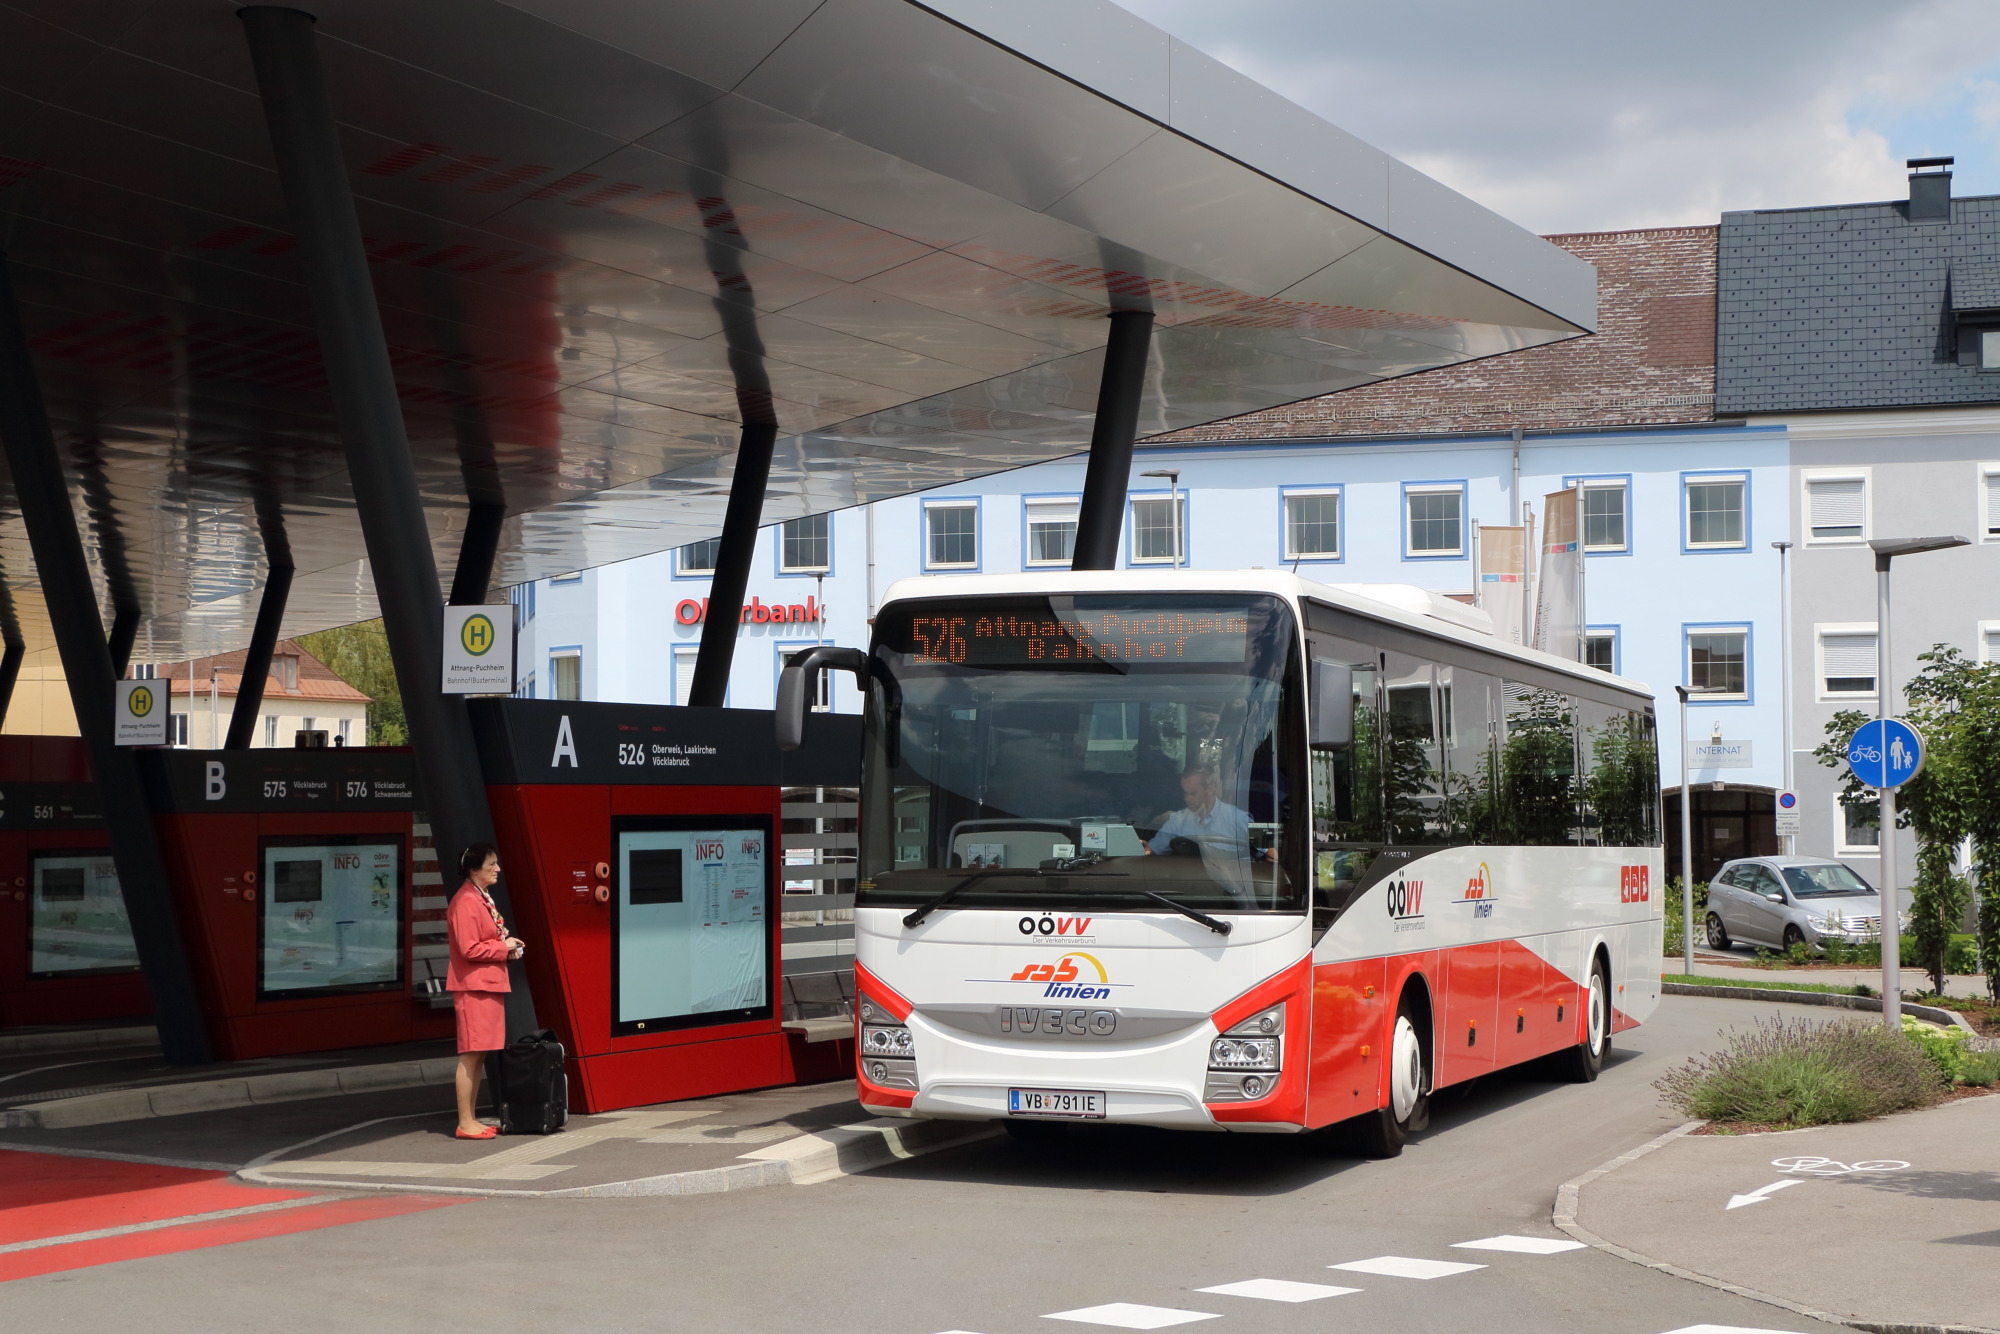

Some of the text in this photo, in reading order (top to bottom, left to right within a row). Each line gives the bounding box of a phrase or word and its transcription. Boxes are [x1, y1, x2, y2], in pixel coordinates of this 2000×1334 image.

[675, 595, 825, 625] Orbank
[471, 626, 485, 646] H
[913, 612, 1247, 663] 526 Attnang-Puchheim
[1028, 636, 1188, 659] Bahnhof
[450, 664, 505, 673] Attnang-Puchheim
[135, 694, 147, 710] H
[551, 715, 578, 768] A
[1695, 745, 1742, 755] INTERNAT
[618, 743, 717, 766] 526 Oberweis, Laakirchen
[652, 756, 690, 767] Vöcklabruck
[206, 760, 226, 801] B
[263, 781, 328, 798] 575 Vöcklabruck
[346, 781, 406, 798] 576 Vöcklabruck
[374, 789, 413, 799] Schwanenstadt
[34, 805, 54, 820] 561
[696, 843, 724, 861] INFO
[334, 856, 360, 870] INFO
[1464, 869, 1484, 899] sab
[1387, 870, 1424, 918] OÖVV
[1473, 900, 1493, 919] linien
[1018, 912, 1092, 936] OÖVV
[1045, 937, 1096, 945] Verkehrsverbund
[1010, 958, 1079, 982] sab
[1043, 982, 1111, 1000] linien
[1000, 1008, 1117, 1036] IVECO
[1025, 1094, 1042, 1109] VB
